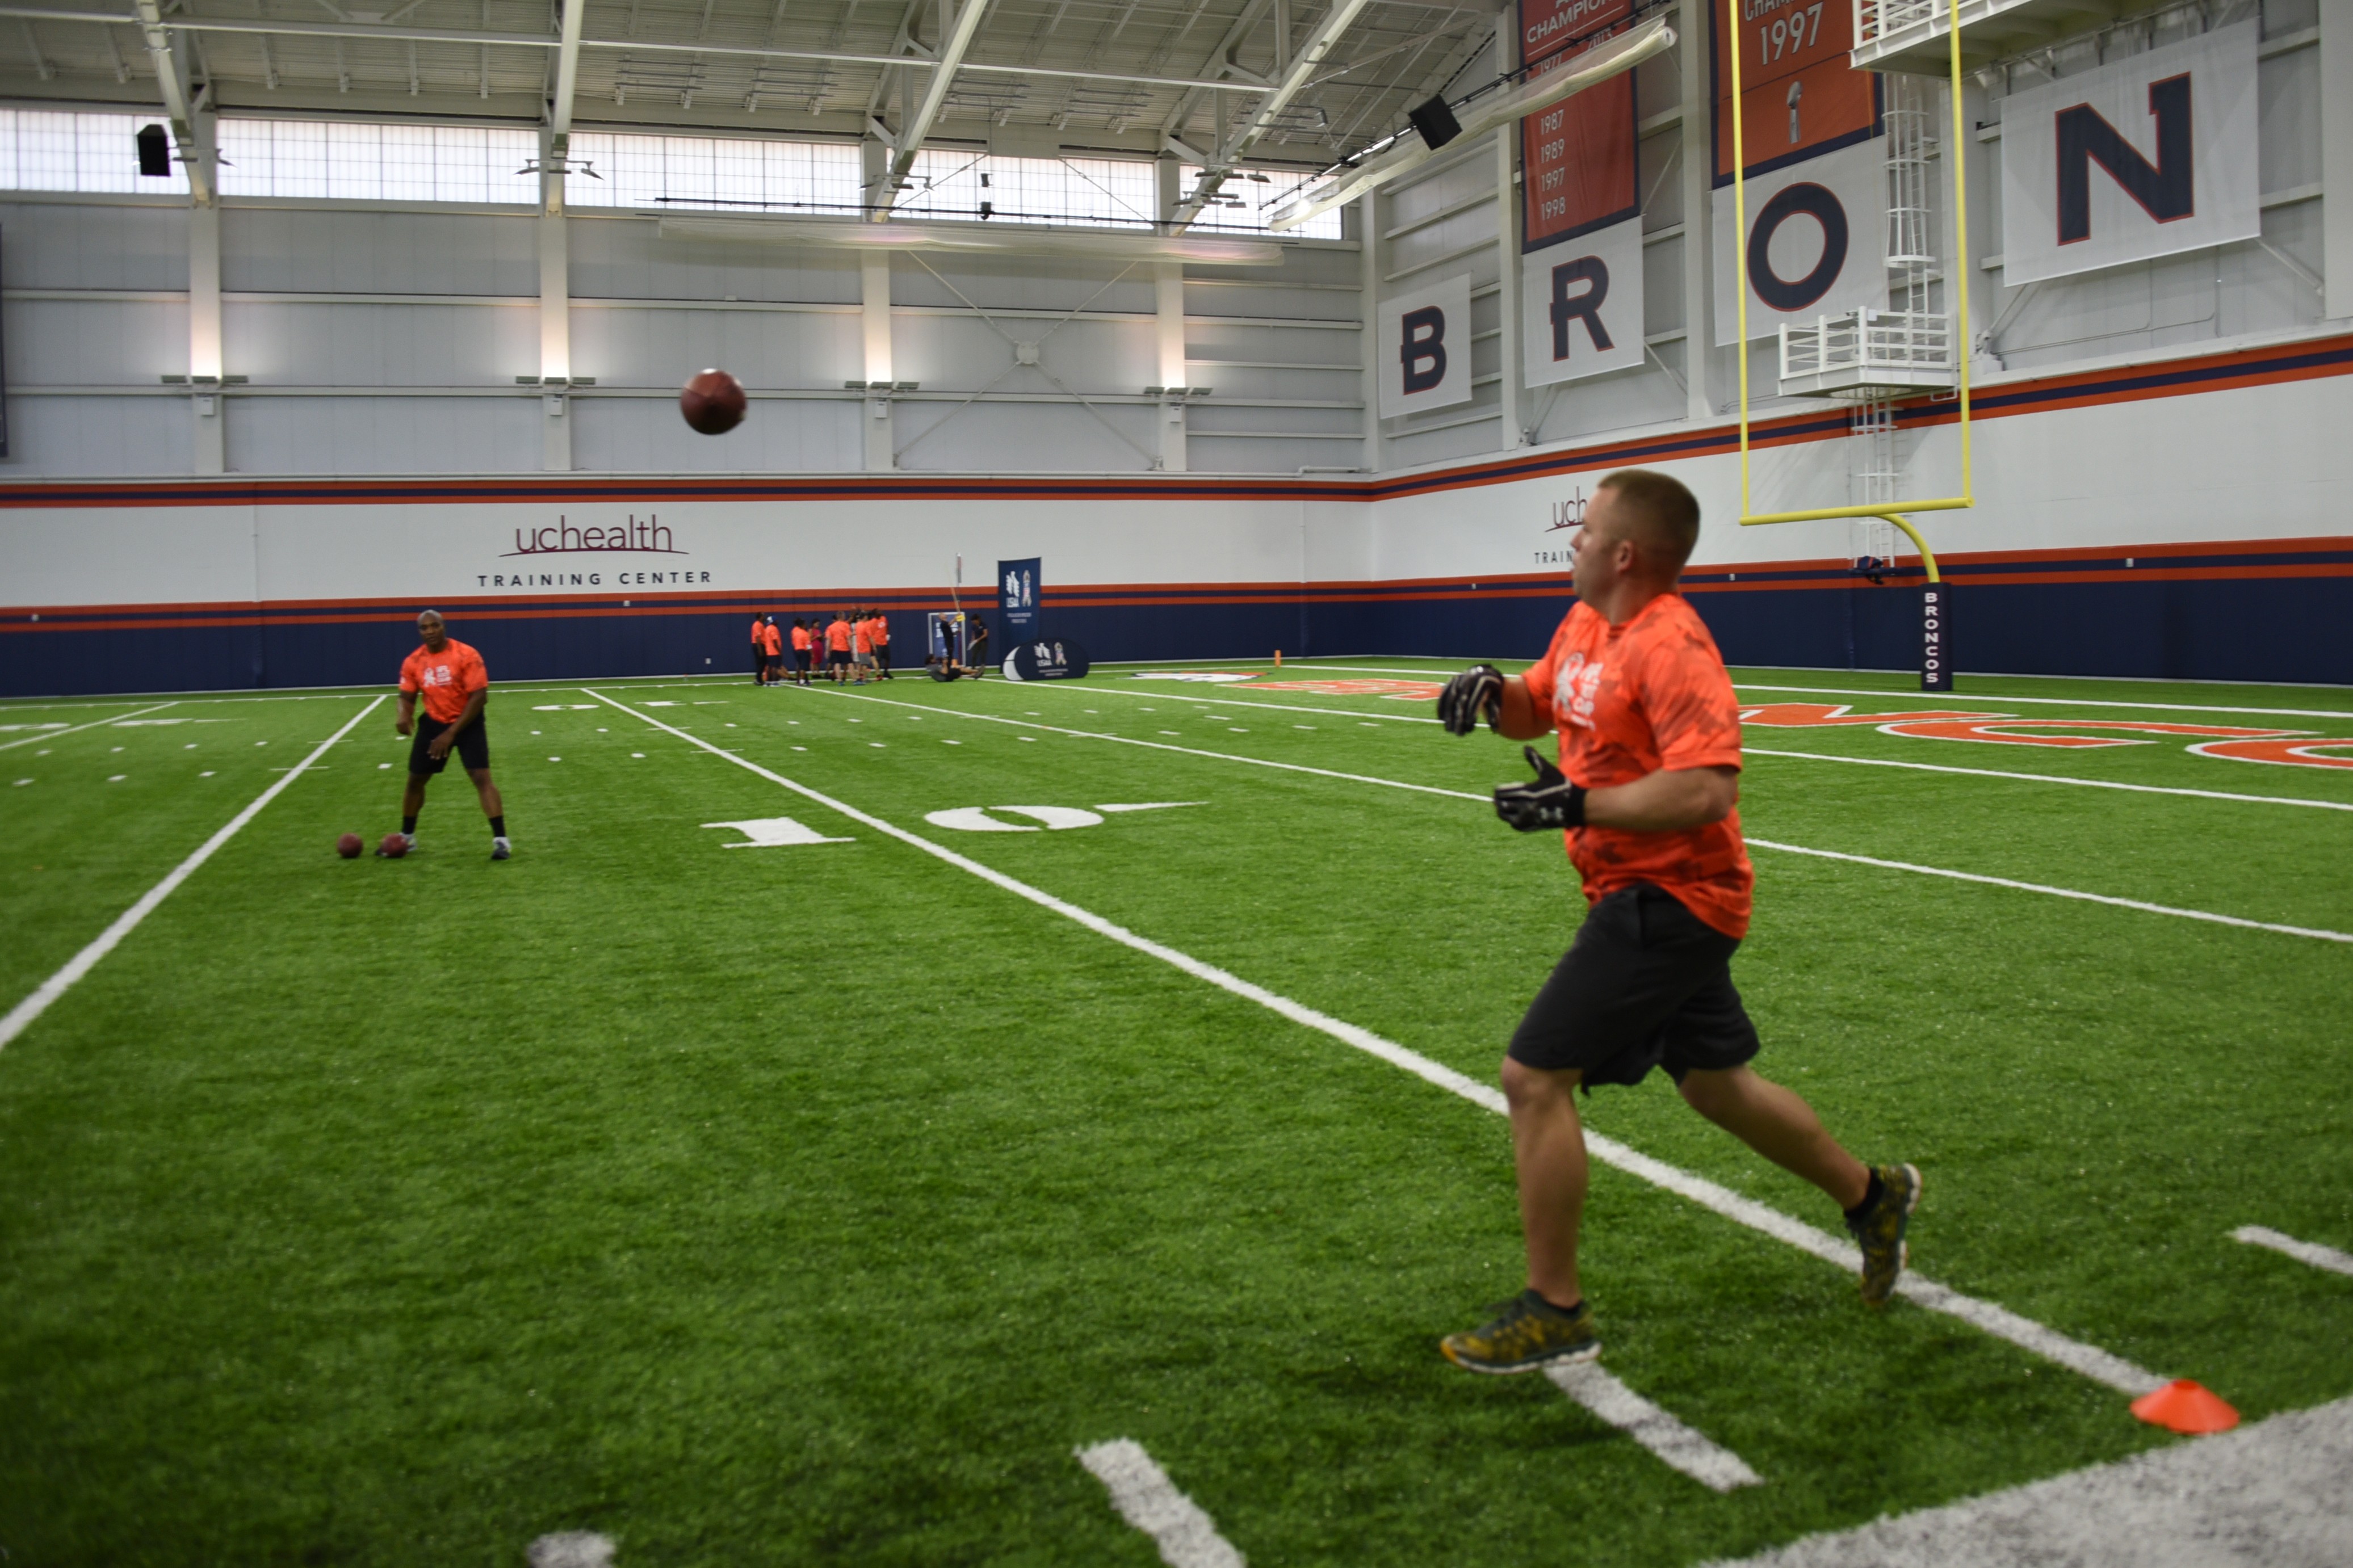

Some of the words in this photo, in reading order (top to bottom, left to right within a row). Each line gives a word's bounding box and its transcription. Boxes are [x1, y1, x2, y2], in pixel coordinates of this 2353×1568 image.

[1527, 0, 1613, 43] CHAMPIO
[1761, 2, 1824, 65] 1997
[1541, 109, 1564, 135] 1987
[1541, 138, 1565, 163] 1989
[2055, 71, 2194, 246] N
[1541, 167, 1565, 192] 1997
[1541, 196, 1566, 220] 1998
[1747, 182, 1848, 312] O
[1550, 255, 1614, 361] R
[1401, 306, 1447, 396] B
[515, 514, 673, 553] uchealth
[1534, 550, 1573, 564] TRAIN
[478, 573, 602, 587] TRAINING
[619, 571, 711, 585] CENTER
[1924, 592, 1939, 683] BRONCOS
[700, 805, 1105, 848] 10
